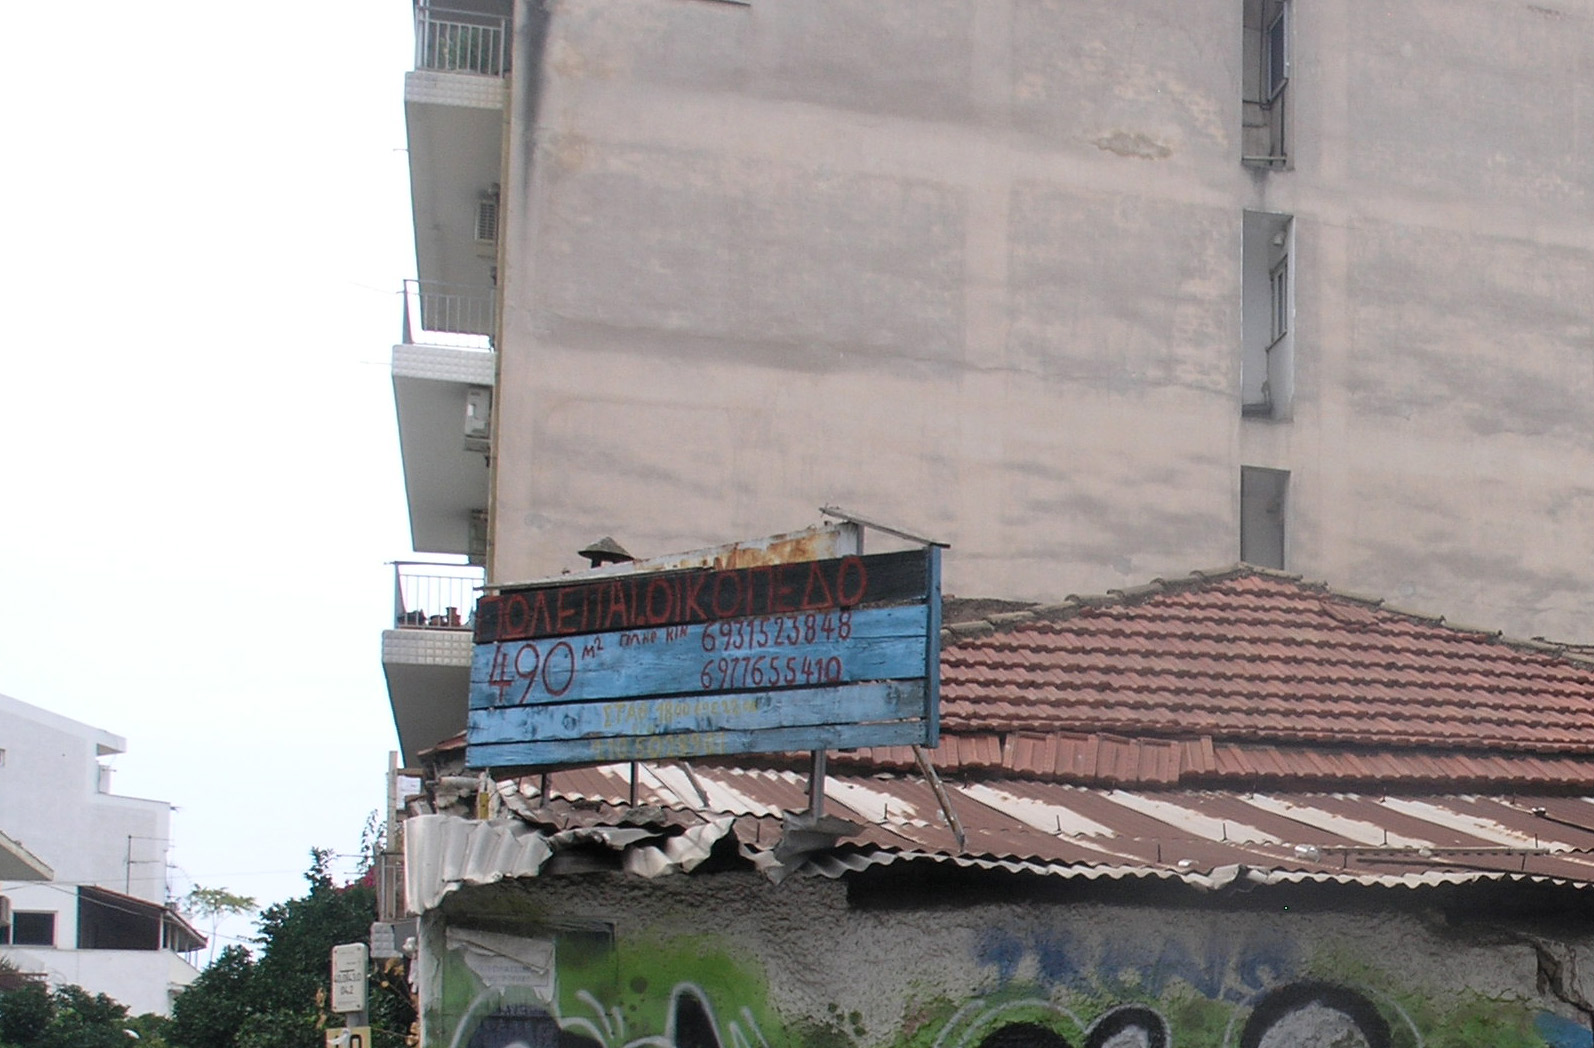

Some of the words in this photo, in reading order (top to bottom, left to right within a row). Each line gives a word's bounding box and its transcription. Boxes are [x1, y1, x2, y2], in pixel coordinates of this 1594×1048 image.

[702, 610, 852, 653] 6931523848
[488, 641, 576, 704] 490
[702, 656, 843, 690] 6977655410
